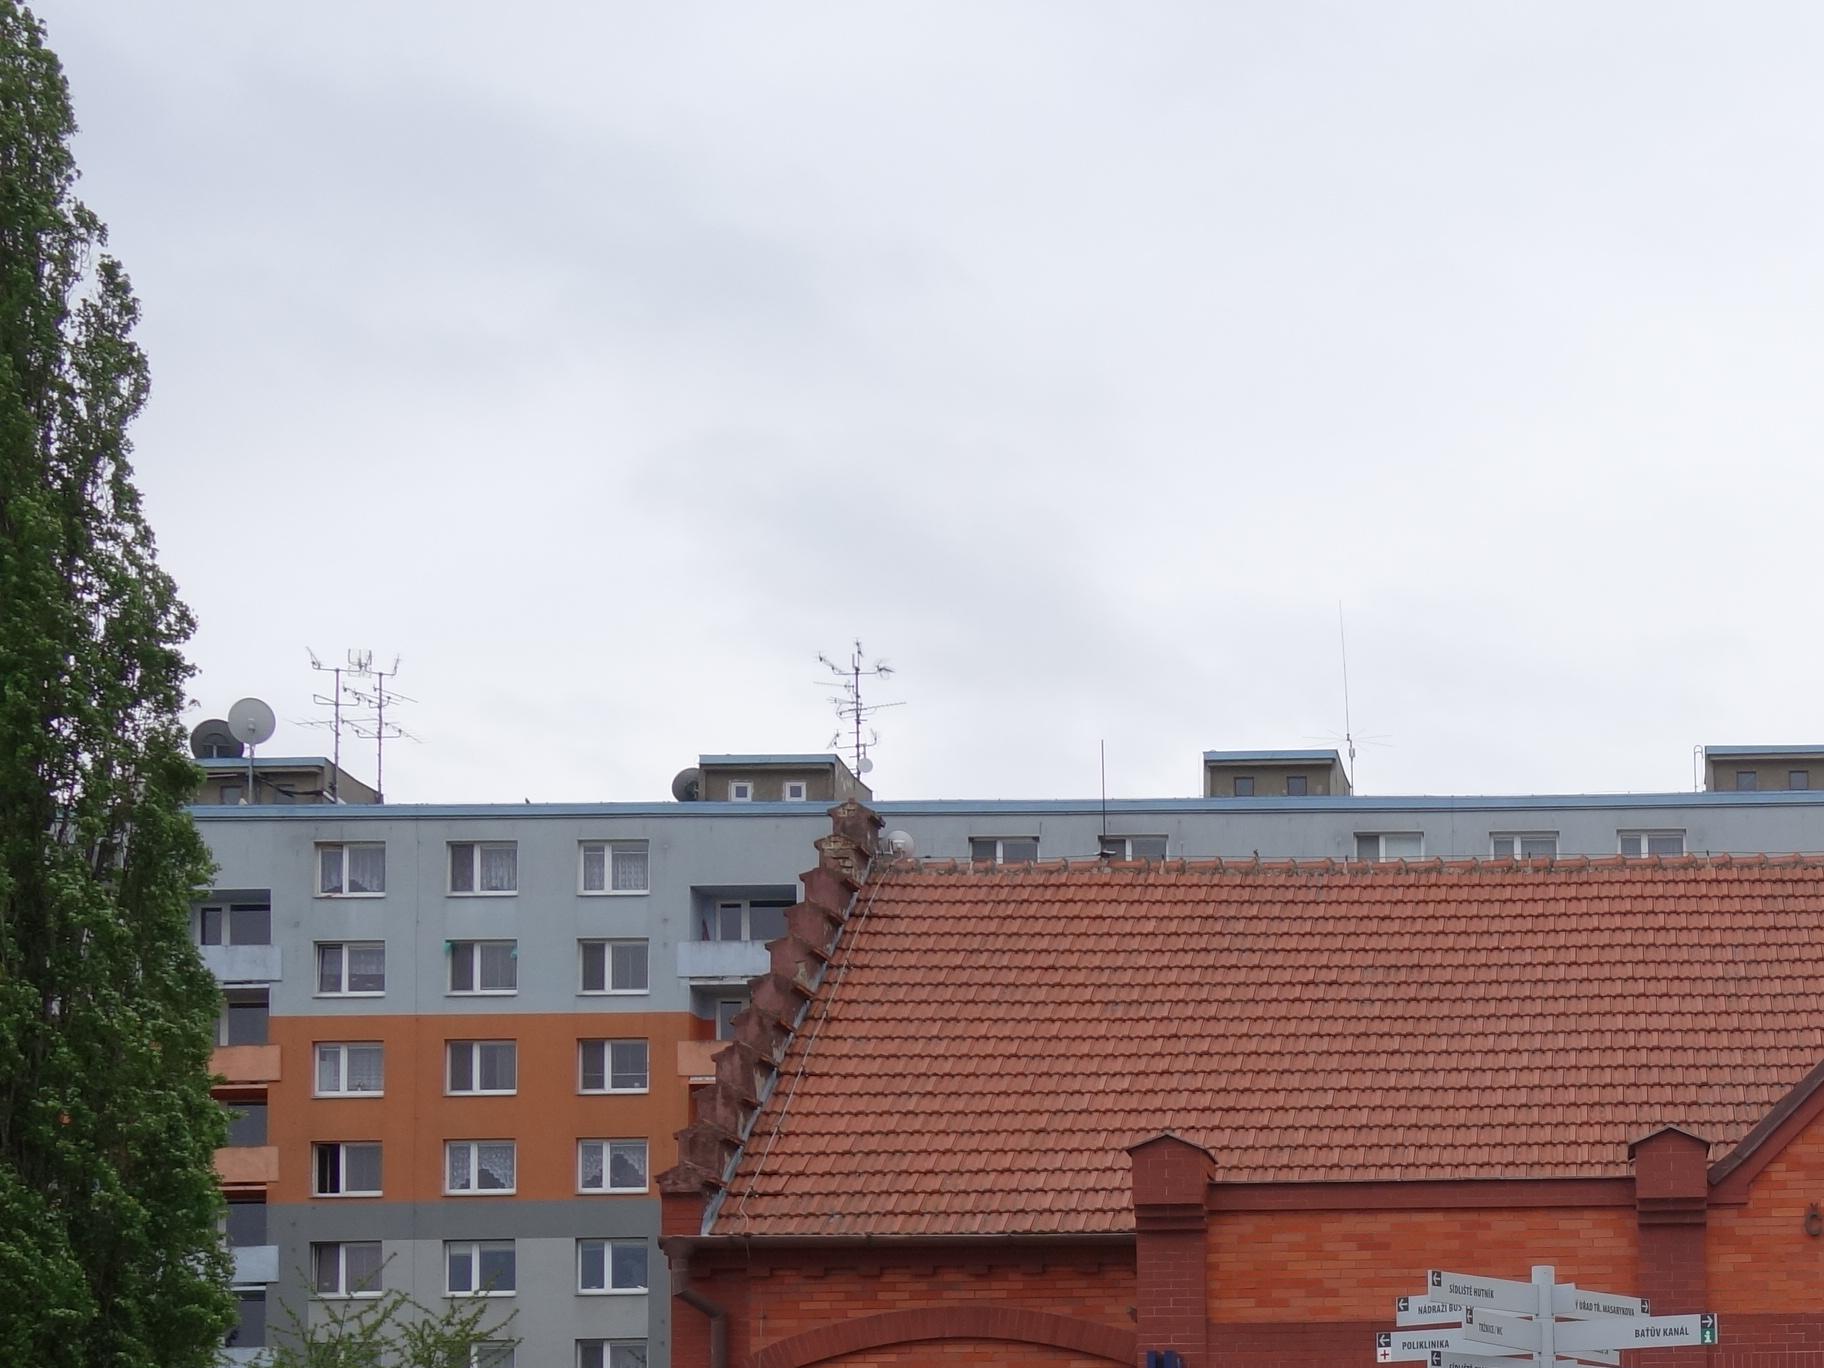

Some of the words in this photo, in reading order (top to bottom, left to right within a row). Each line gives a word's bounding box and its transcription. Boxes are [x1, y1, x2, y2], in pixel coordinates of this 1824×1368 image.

[1449, 1283, 1472, 1296] SÍDLIŠTĚ
[1473, 1286, 1494, 1299] HUTNÍK
[1634, 1326, 1661, 1338] BAŤŮV
[1662, 1326, 1689, 1337] KANÁL
[1402, 1339, 1449, 1350] POLIKLINIKA
